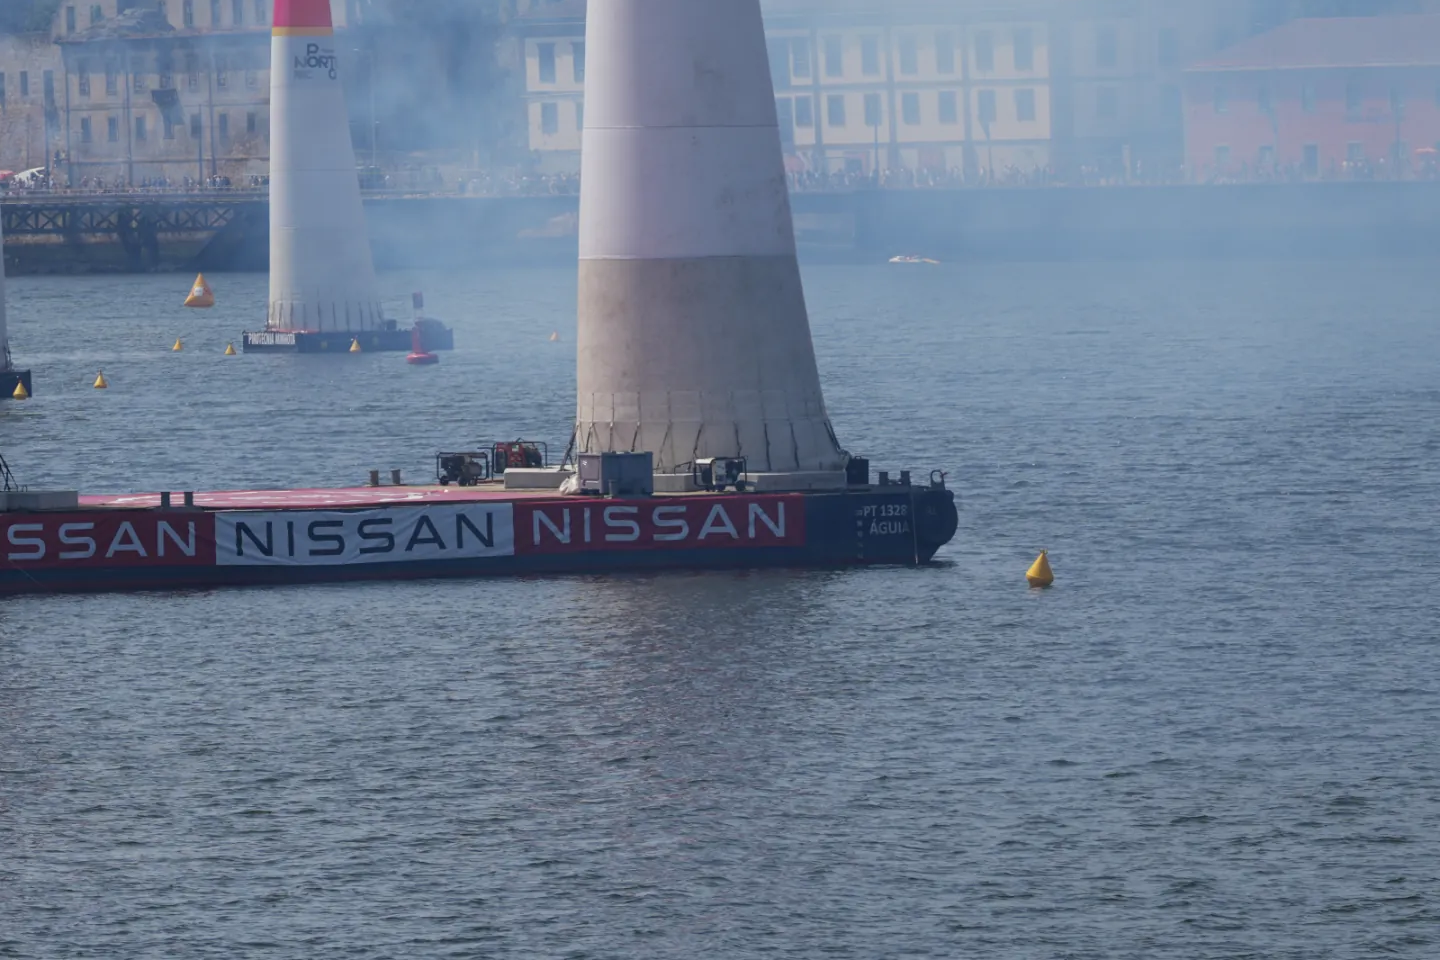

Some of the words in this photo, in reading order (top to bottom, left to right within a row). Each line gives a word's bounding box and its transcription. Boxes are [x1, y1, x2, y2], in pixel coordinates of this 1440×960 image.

[533, 501, 785, 545] NISSAN
[862, 505, 878, 517] PT
[880, 504, 908, 517] 1328
[235, 512, 495, 557] NISSAN
[869, 518, 910, 535] ÁGUIA
